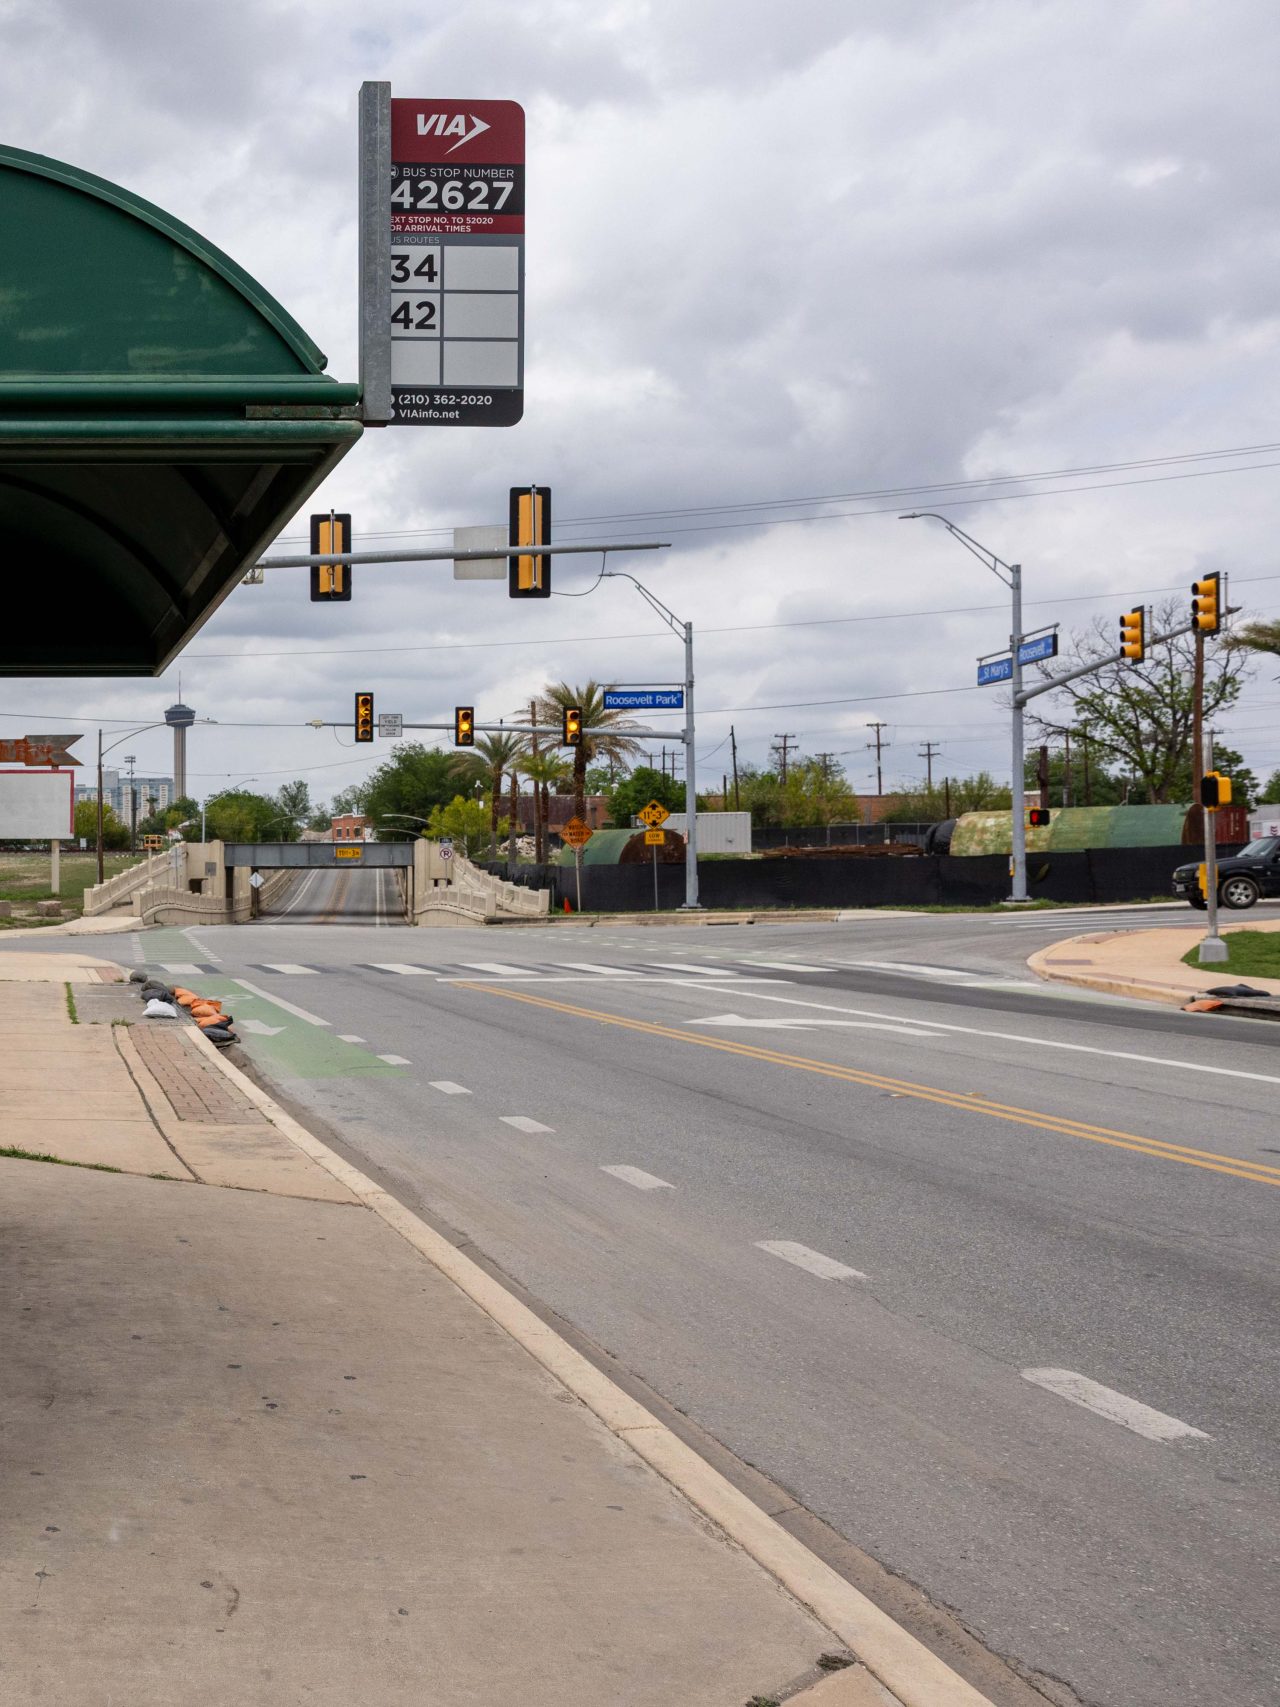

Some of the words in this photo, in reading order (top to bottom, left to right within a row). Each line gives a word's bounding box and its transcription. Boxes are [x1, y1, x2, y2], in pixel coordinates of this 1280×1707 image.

[417, 114, 466, 136] VIA
[403, 168, 427, 178] BUS
[430, 168, 461, 178] STOP
[464, 169, 514, 178] NUMBER
[391, 180, 514, 210] 42627
[404, 236, 440, 244] ROUTES
[391, 254, 438, 283] 34
[391, 301, 437, 330] 42
[399, 394, 430, 406] (210)
[433, 394, 493, 405] 362-2020
[400, 408, 460, 419] VIAinfo.net
[605, 695, 653, 705] Roosevelt
[656, 694, 678, 705] Park
